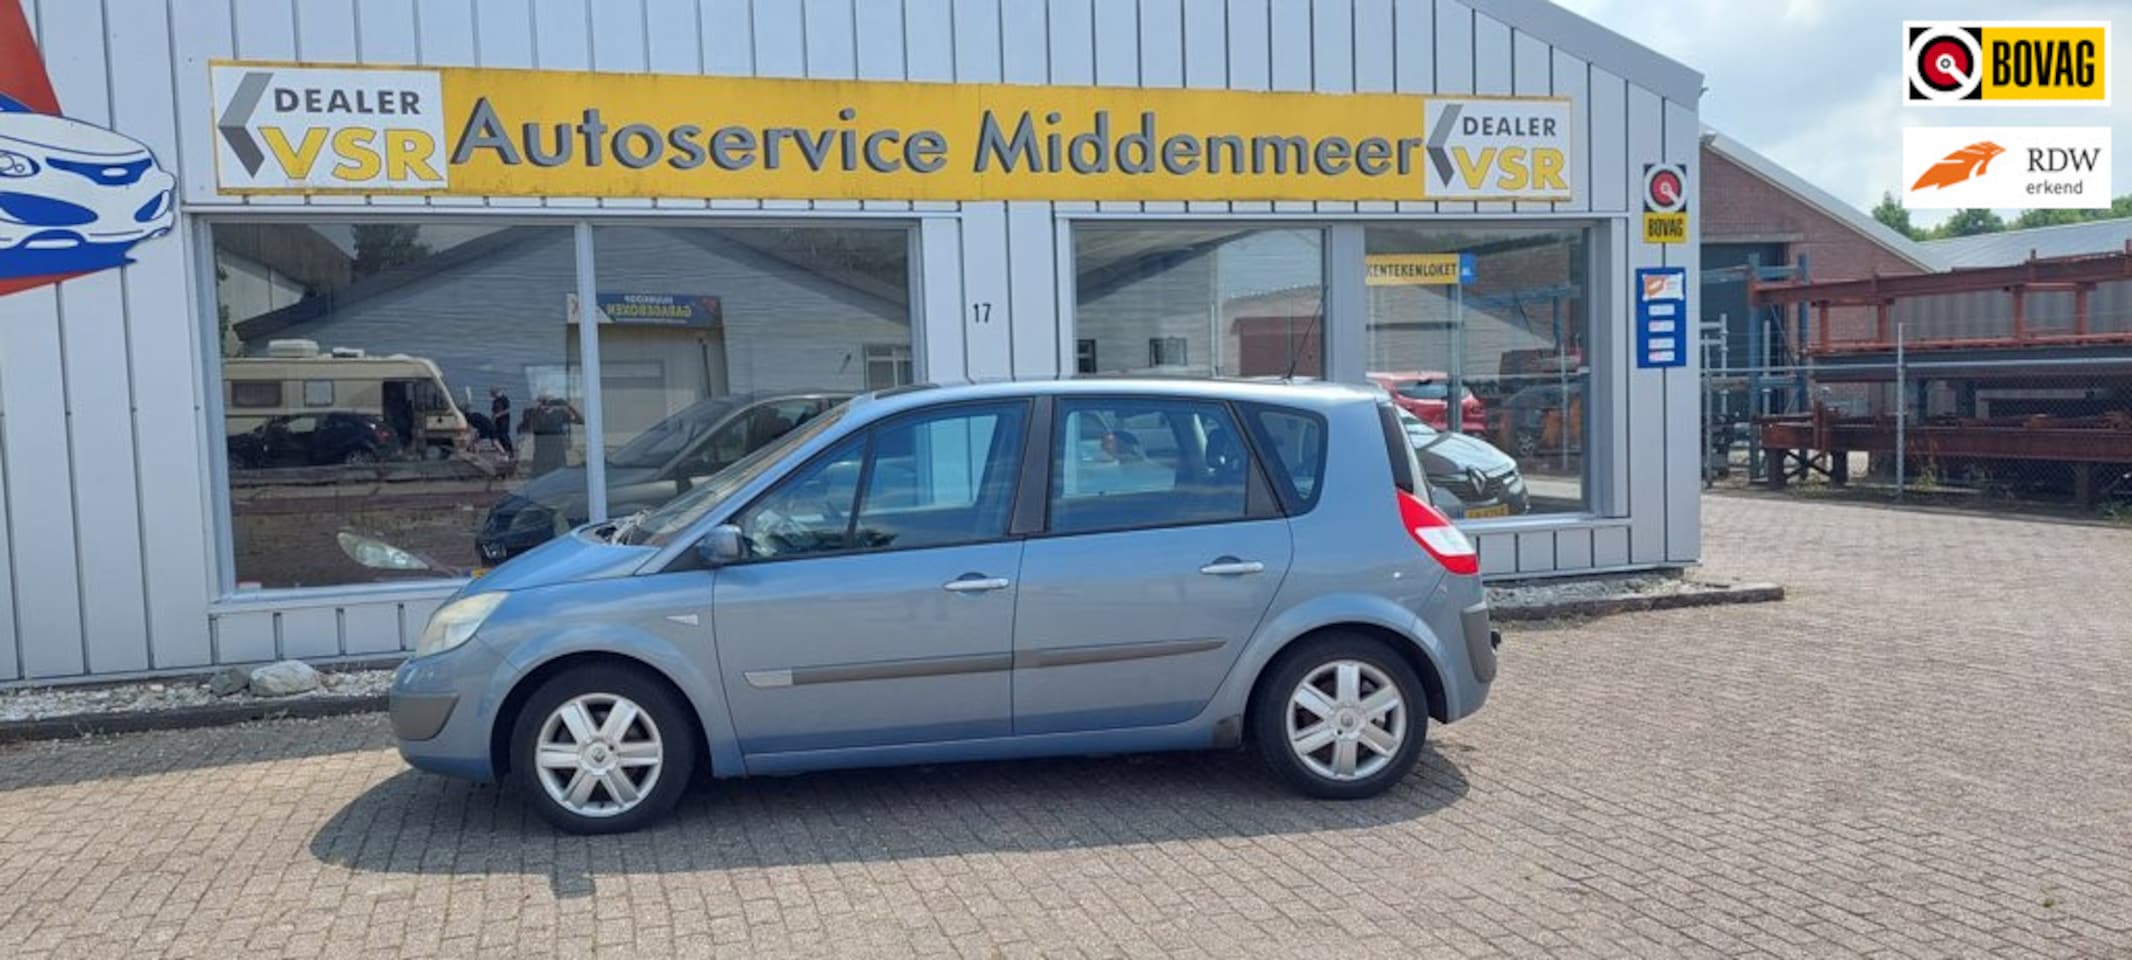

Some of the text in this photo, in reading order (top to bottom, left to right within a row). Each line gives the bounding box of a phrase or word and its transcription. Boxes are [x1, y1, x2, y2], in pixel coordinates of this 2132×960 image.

[273, 87, 421, 115] DEALER
[450, 97, 1421, 176] Autoservice Middenmeer
[1462, 115, 1557, 138] DEALER
[258, 126, 443, 183] VSR
[1452, 147, 1569, 191] VSR
[1648, 218, 1684, 237] BOVAG
[973, 303, 992, 323] 17
